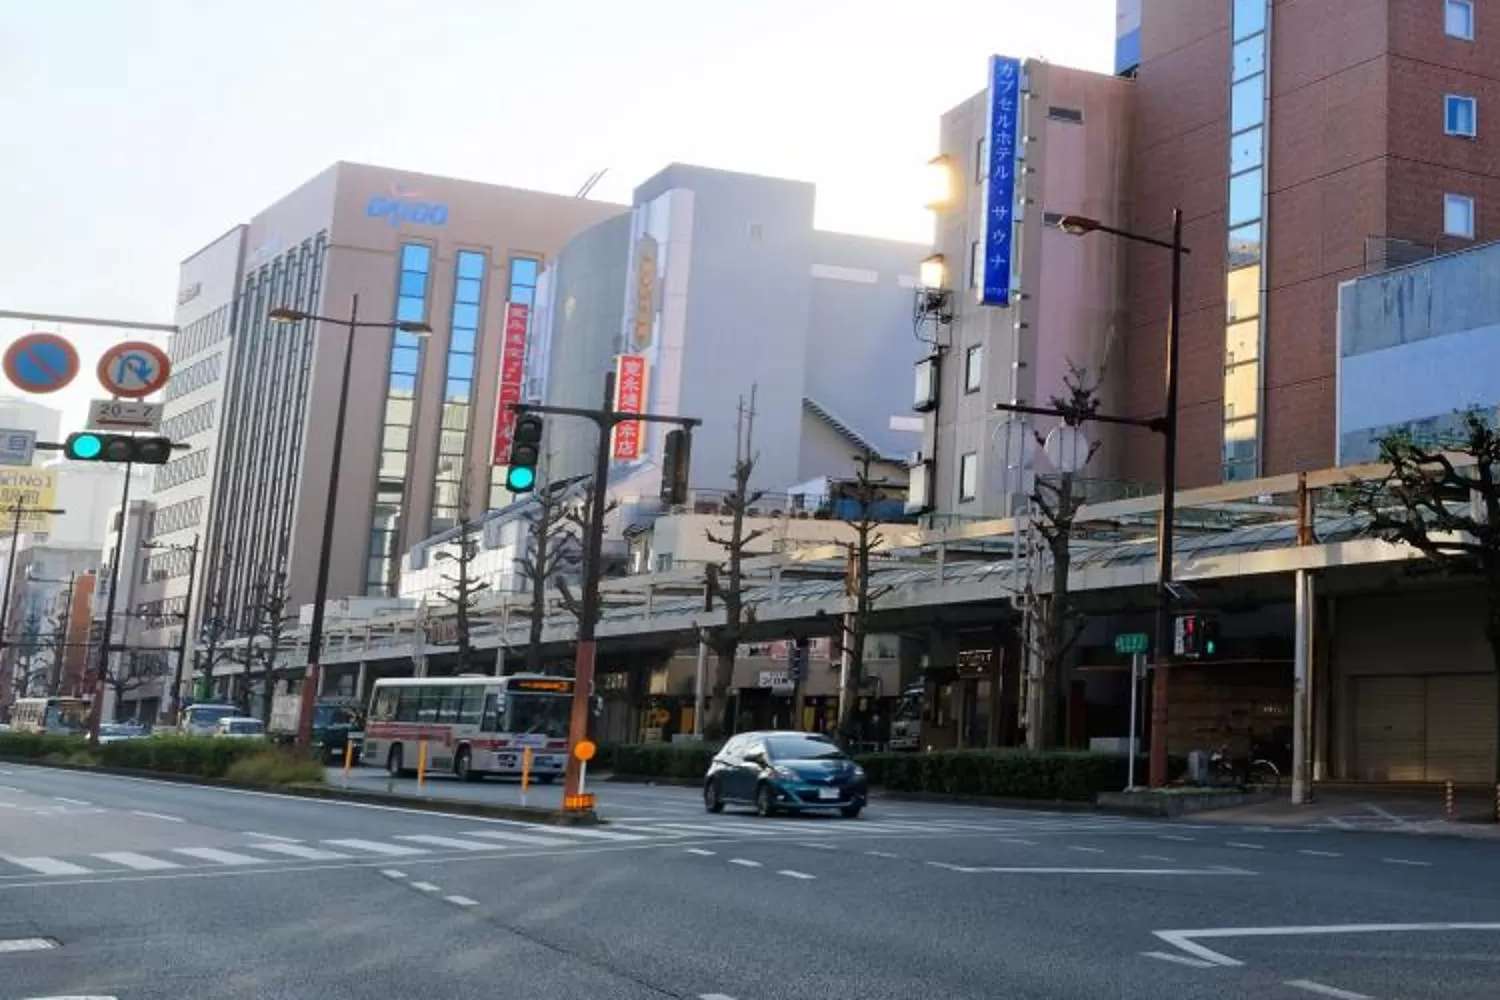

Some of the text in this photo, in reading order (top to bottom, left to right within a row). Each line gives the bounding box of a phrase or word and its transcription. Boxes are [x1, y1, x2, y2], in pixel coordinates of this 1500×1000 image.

[989, 63, 1014, 270] カプセルホテル・サウナ
